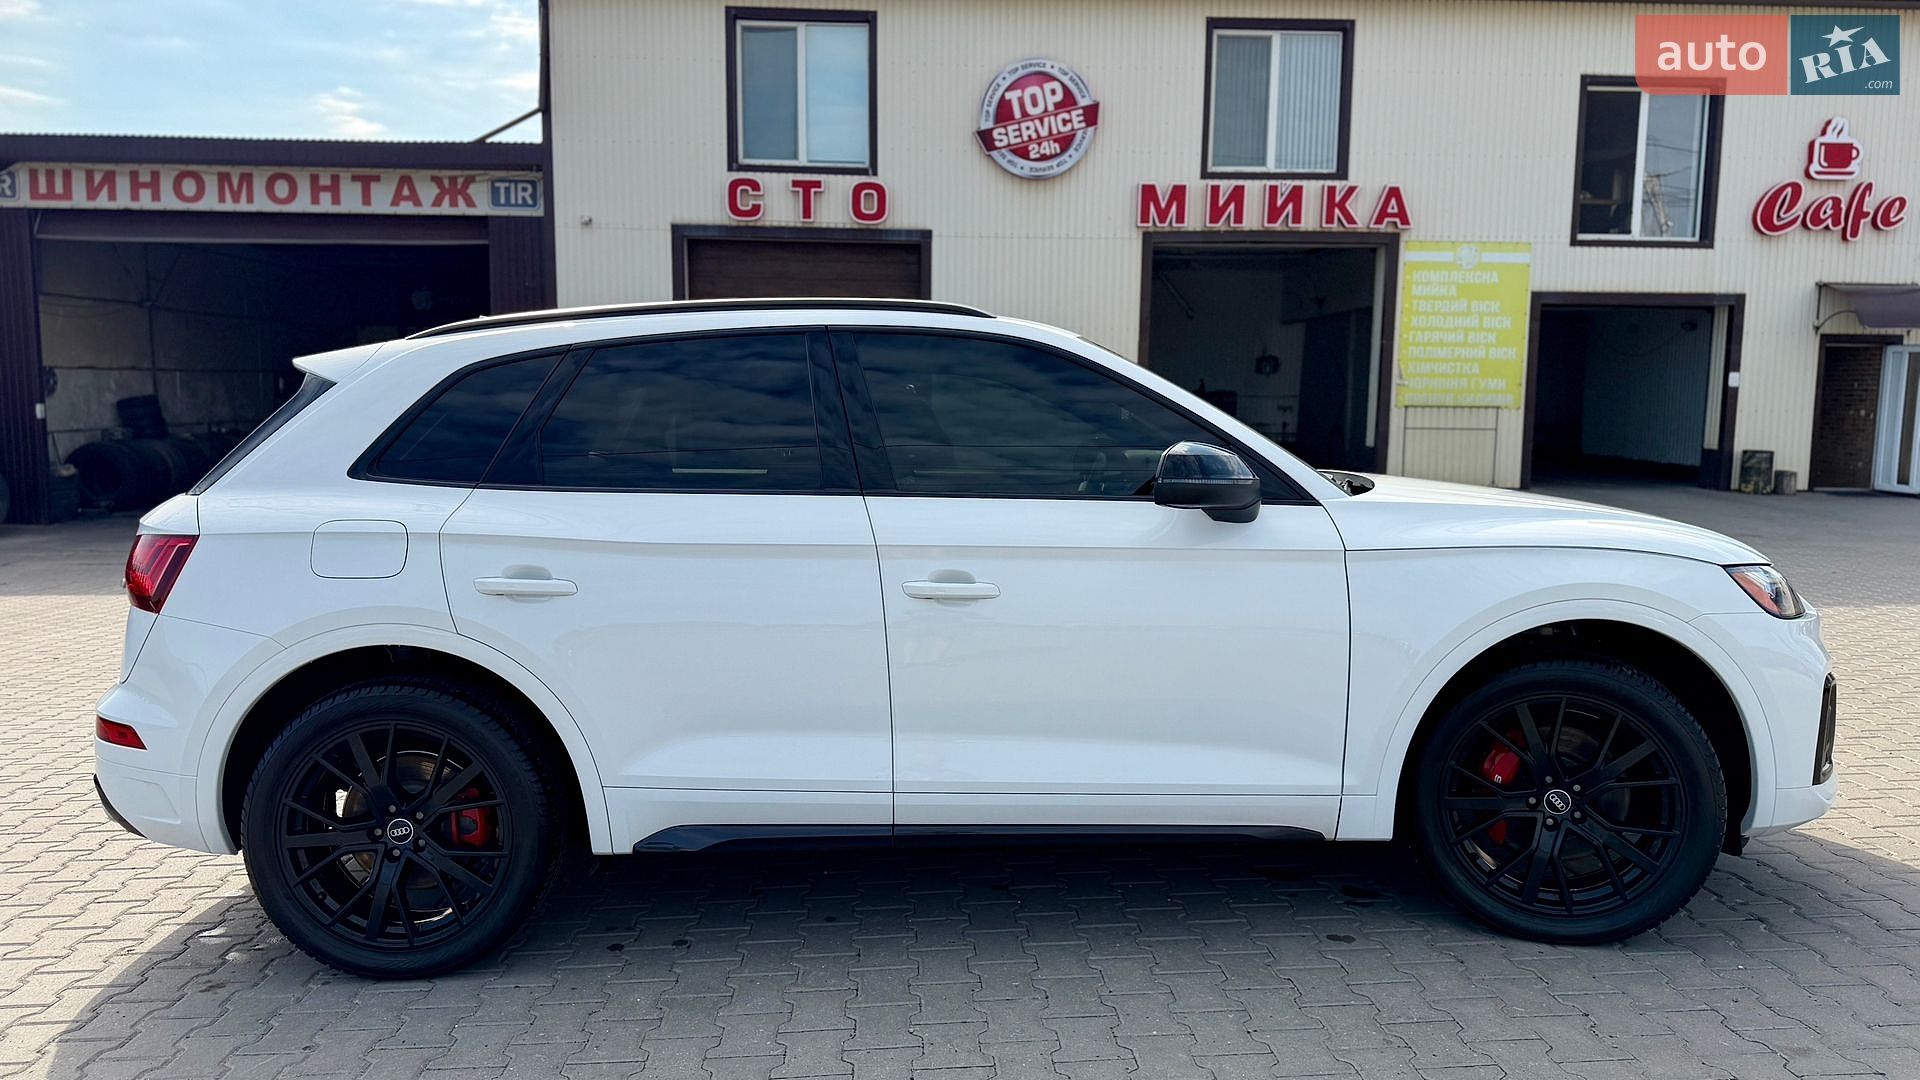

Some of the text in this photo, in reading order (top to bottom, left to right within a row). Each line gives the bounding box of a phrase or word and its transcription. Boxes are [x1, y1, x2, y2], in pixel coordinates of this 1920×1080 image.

[1004, 80, 1064, 120] TOP
[992, 109, 1086, 148] SERVICE
[1028, 140, 1061, 160] 24h
[29, 168, 478, 208] ШИНОМОНТАЖ
[493, 181, 534, 205] TIR
[727, 177, 889, 225] СТО
[1752, 180, 1907, 241] Cafe
[1412, 271, 1499, 284] КОМПЛЕКСНА
[1412, 299, 1501, 313] ТВЕРДИЙ ВІСК
[1411, 314, 1512, 329] ХОЛОДНИЙ ВІСК
[1409, 331, 1496, 345] ГАРЯЧИЙ ВІСК
[1408, 345, 1517, 359] ПОЛІМЕРНИЙ ВІСК
